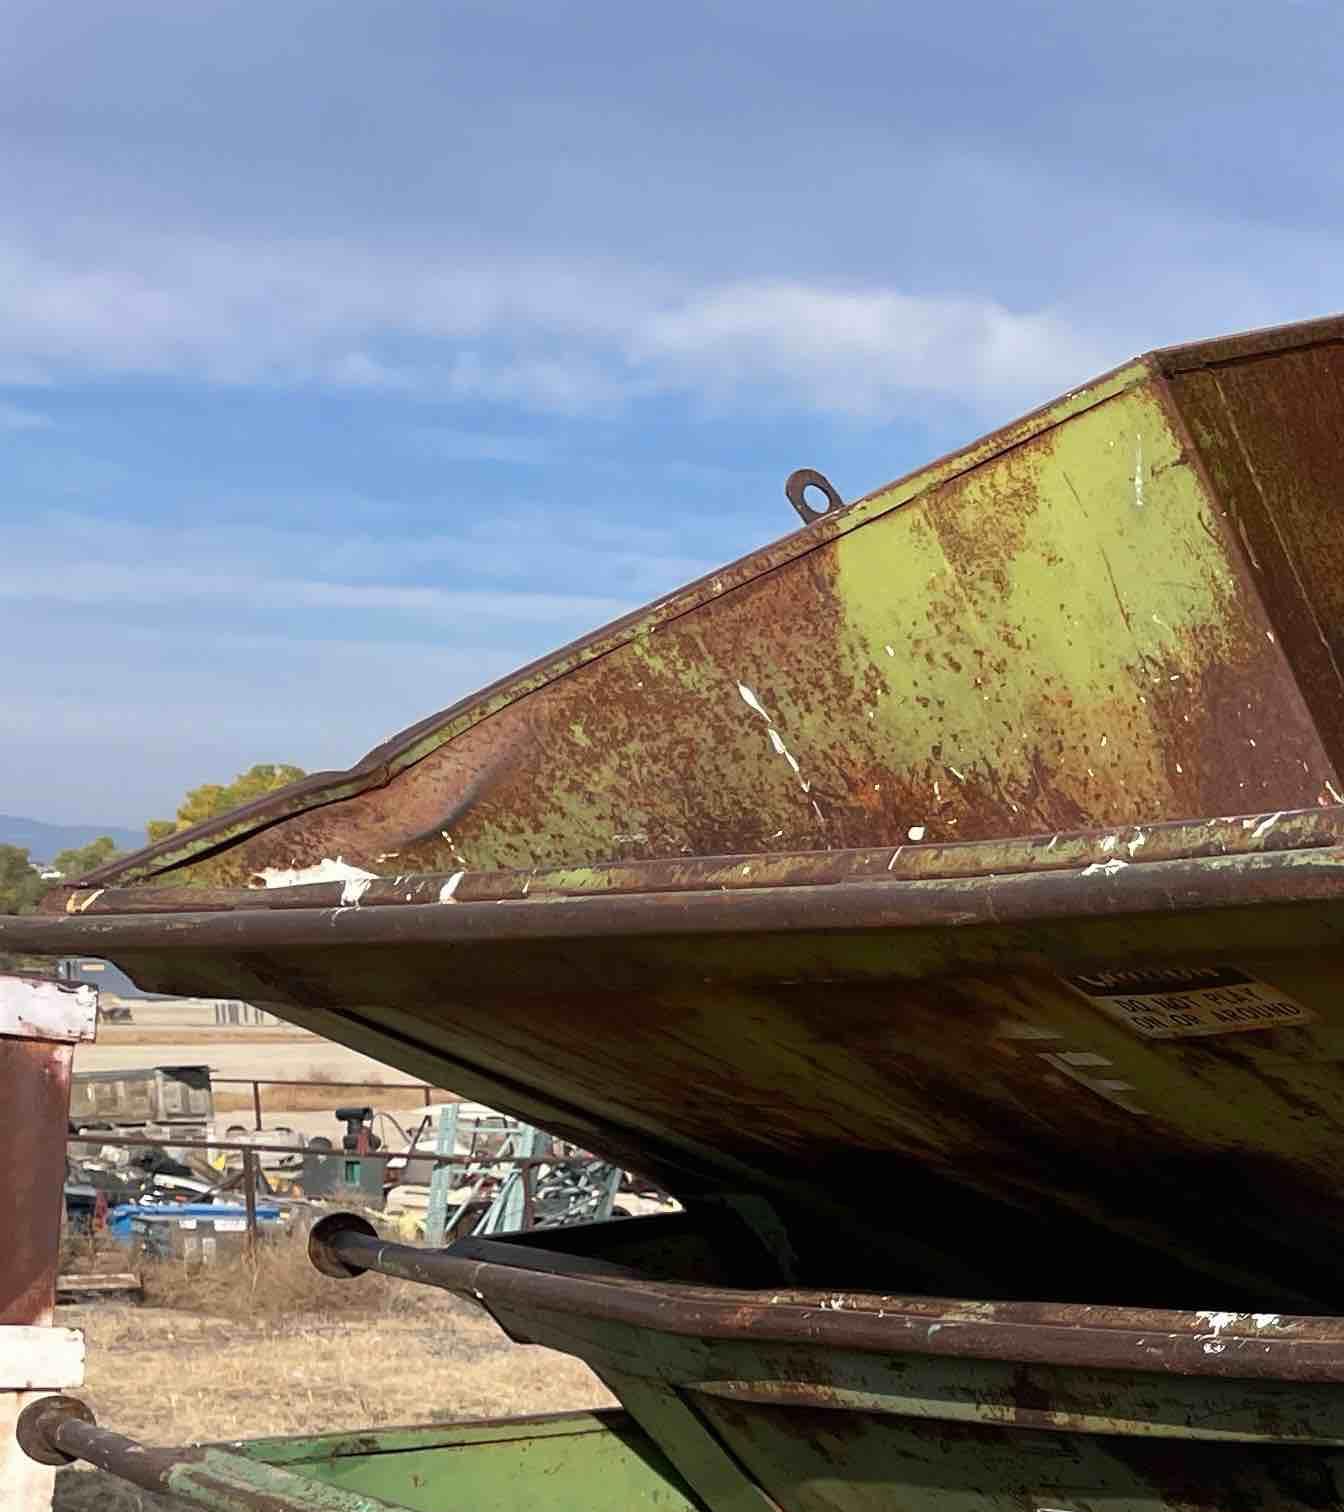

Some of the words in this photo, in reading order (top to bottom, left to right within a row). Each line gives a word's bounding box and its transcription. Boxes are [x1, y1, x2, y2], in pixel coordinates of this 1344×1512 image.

[1120, 999, 1152, 1011] DO
[1152, 995, 1201, 1009] NOT
[1201, 987, 1265, 1004] PLAY
[1211, 1001, 1301, 1023] AROUND
